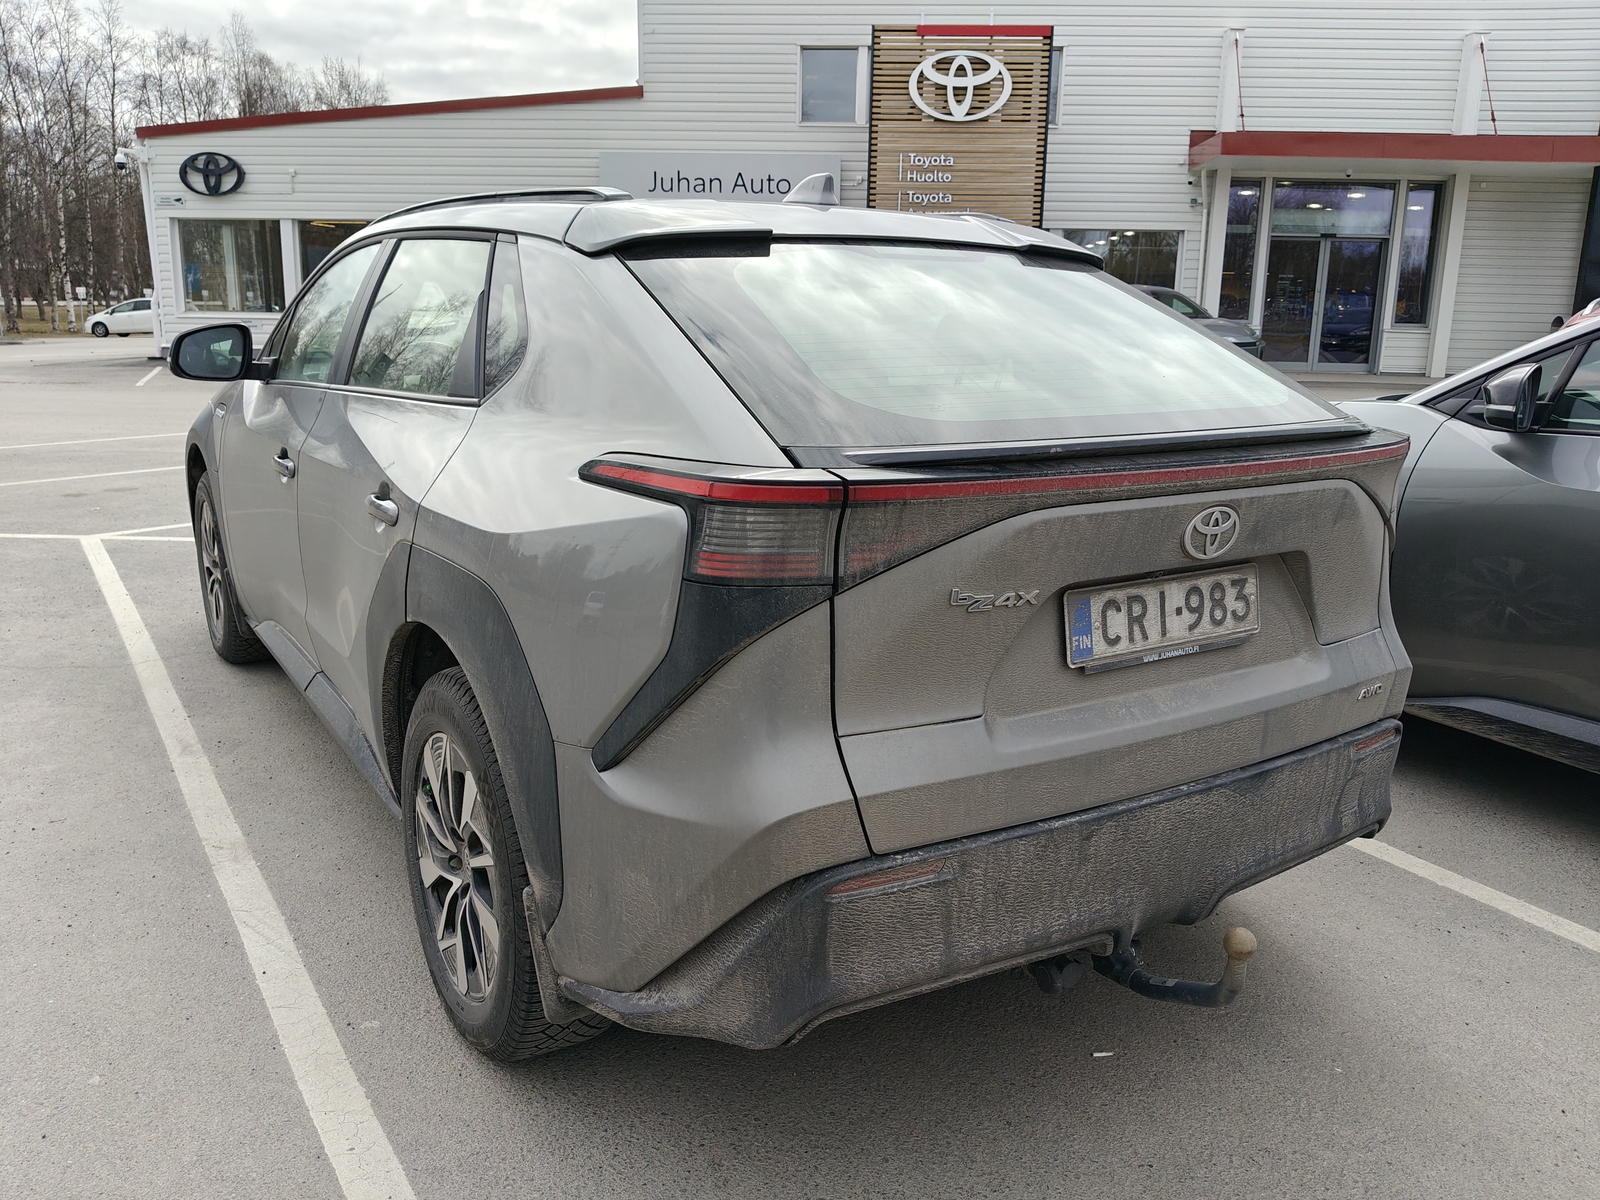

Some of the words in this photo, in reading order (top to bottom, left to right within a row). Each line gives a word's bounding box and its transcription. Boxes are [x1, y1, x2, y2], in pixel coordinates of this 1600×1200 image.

[908, 153, 954, 169] Toyota
[648, 170, 723, 194] Juhan
[731, 172, 792, 195] Auto
[907, 169, 952, 182] Huolto
[906, 191, 953, 206] Toyota
[1101, 577, 1251, 647] CRI-983
[1072, 633, 1092, 651] FIN
